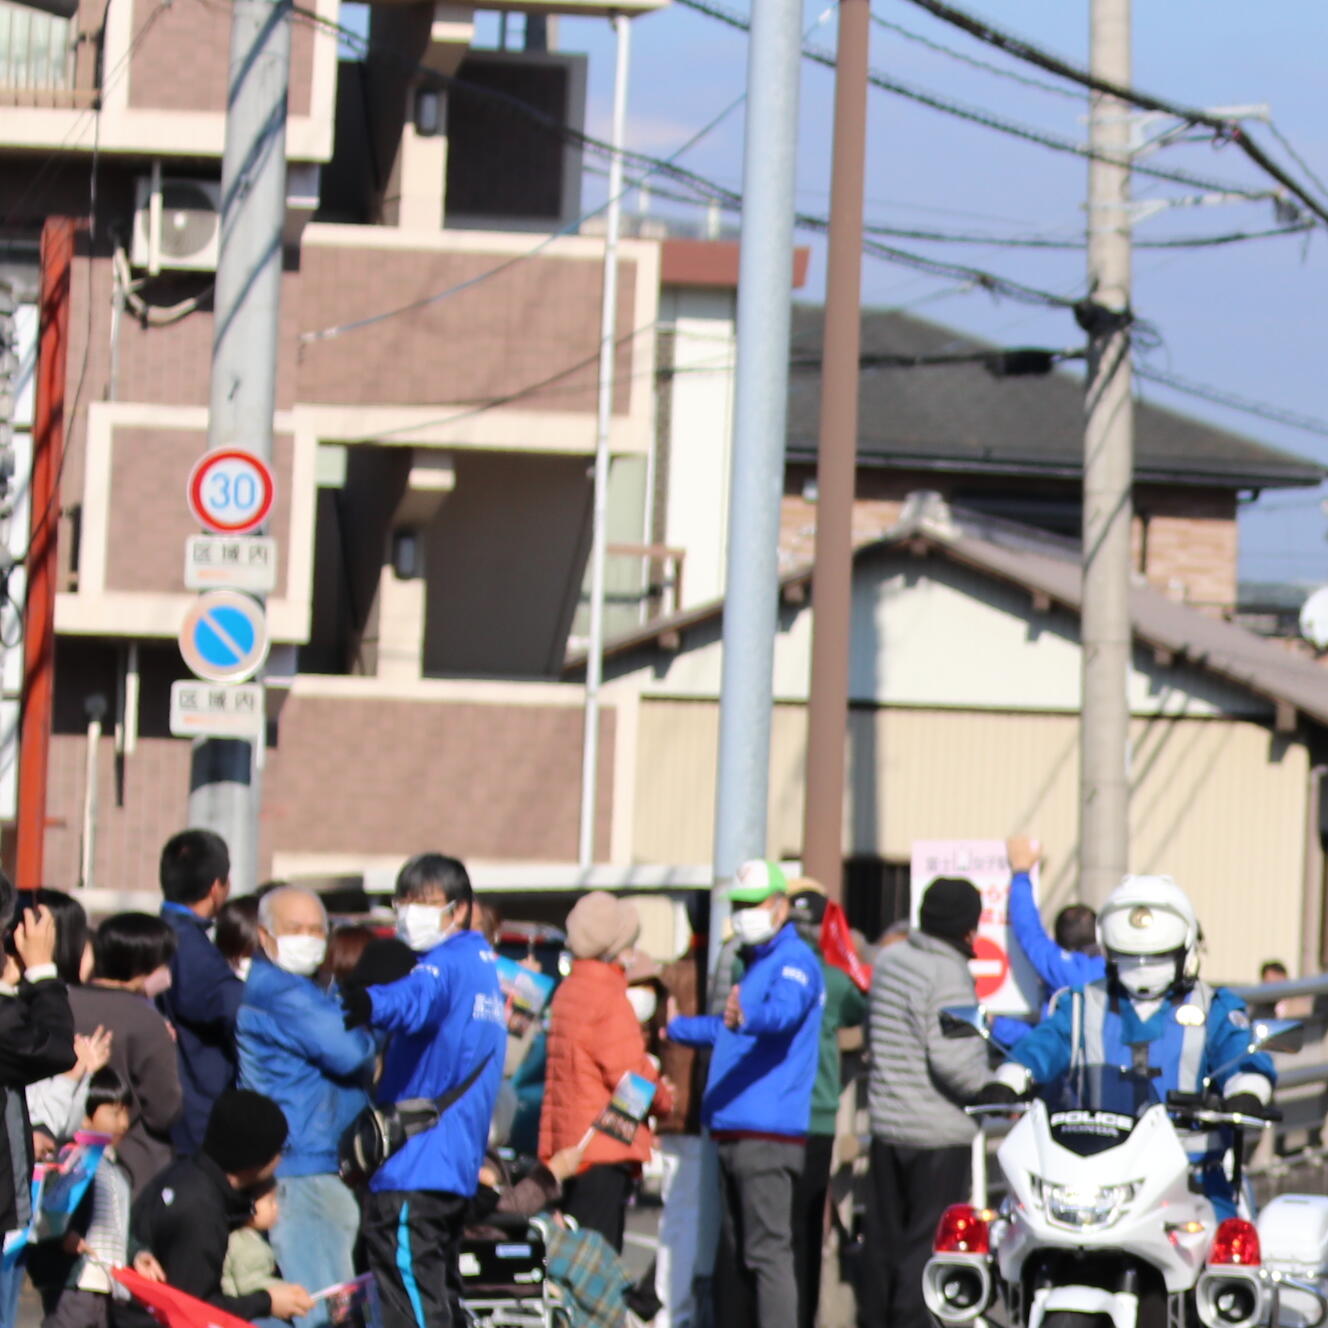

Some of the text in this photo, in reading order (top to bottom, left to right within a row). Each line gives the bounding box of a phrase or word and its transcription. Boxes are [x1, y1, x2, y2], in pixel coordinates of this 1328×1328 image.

[209, 471, 256, 510] 30
[192, 542, 268, 565] 区域内
[179, 688, 254, 711] 区域内
[1051, 1110, 1134, 1131] POLICE
